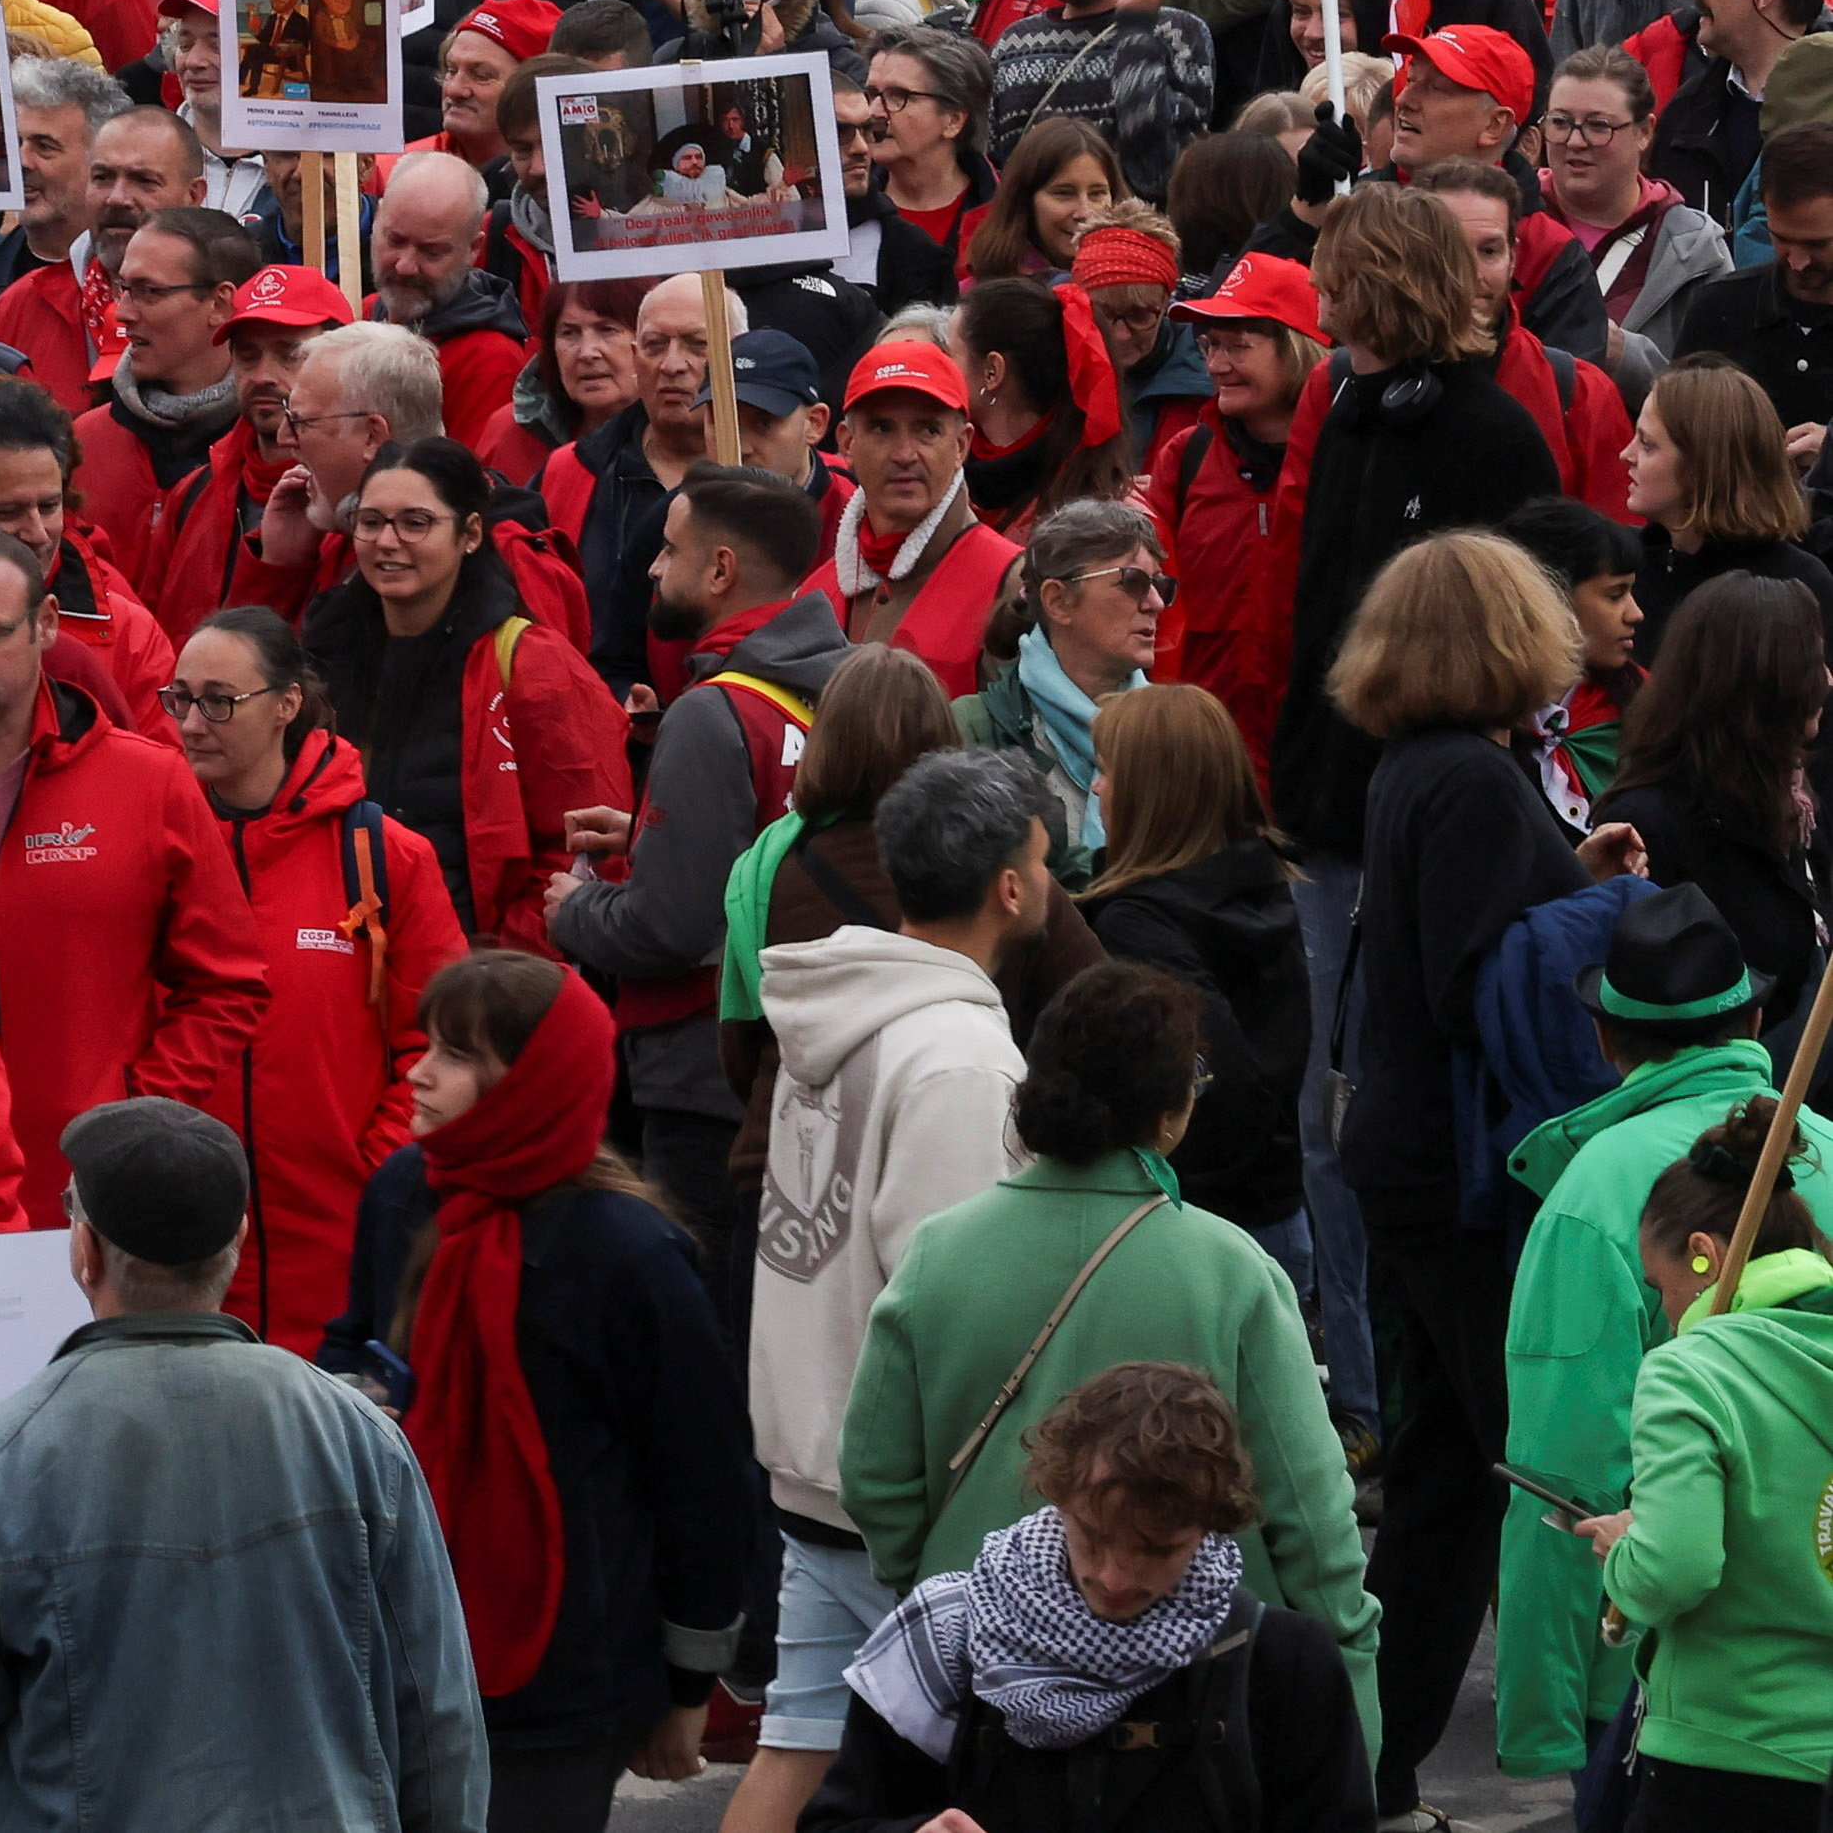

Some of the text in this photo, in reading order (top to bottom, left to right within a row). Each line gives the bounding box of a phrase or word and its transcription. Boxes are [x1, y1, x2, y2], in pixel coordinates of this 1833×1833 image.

[625, 207, 773, 231] Doe zoals gewoonlijk
[300, 931, 333, 941] CGSP
